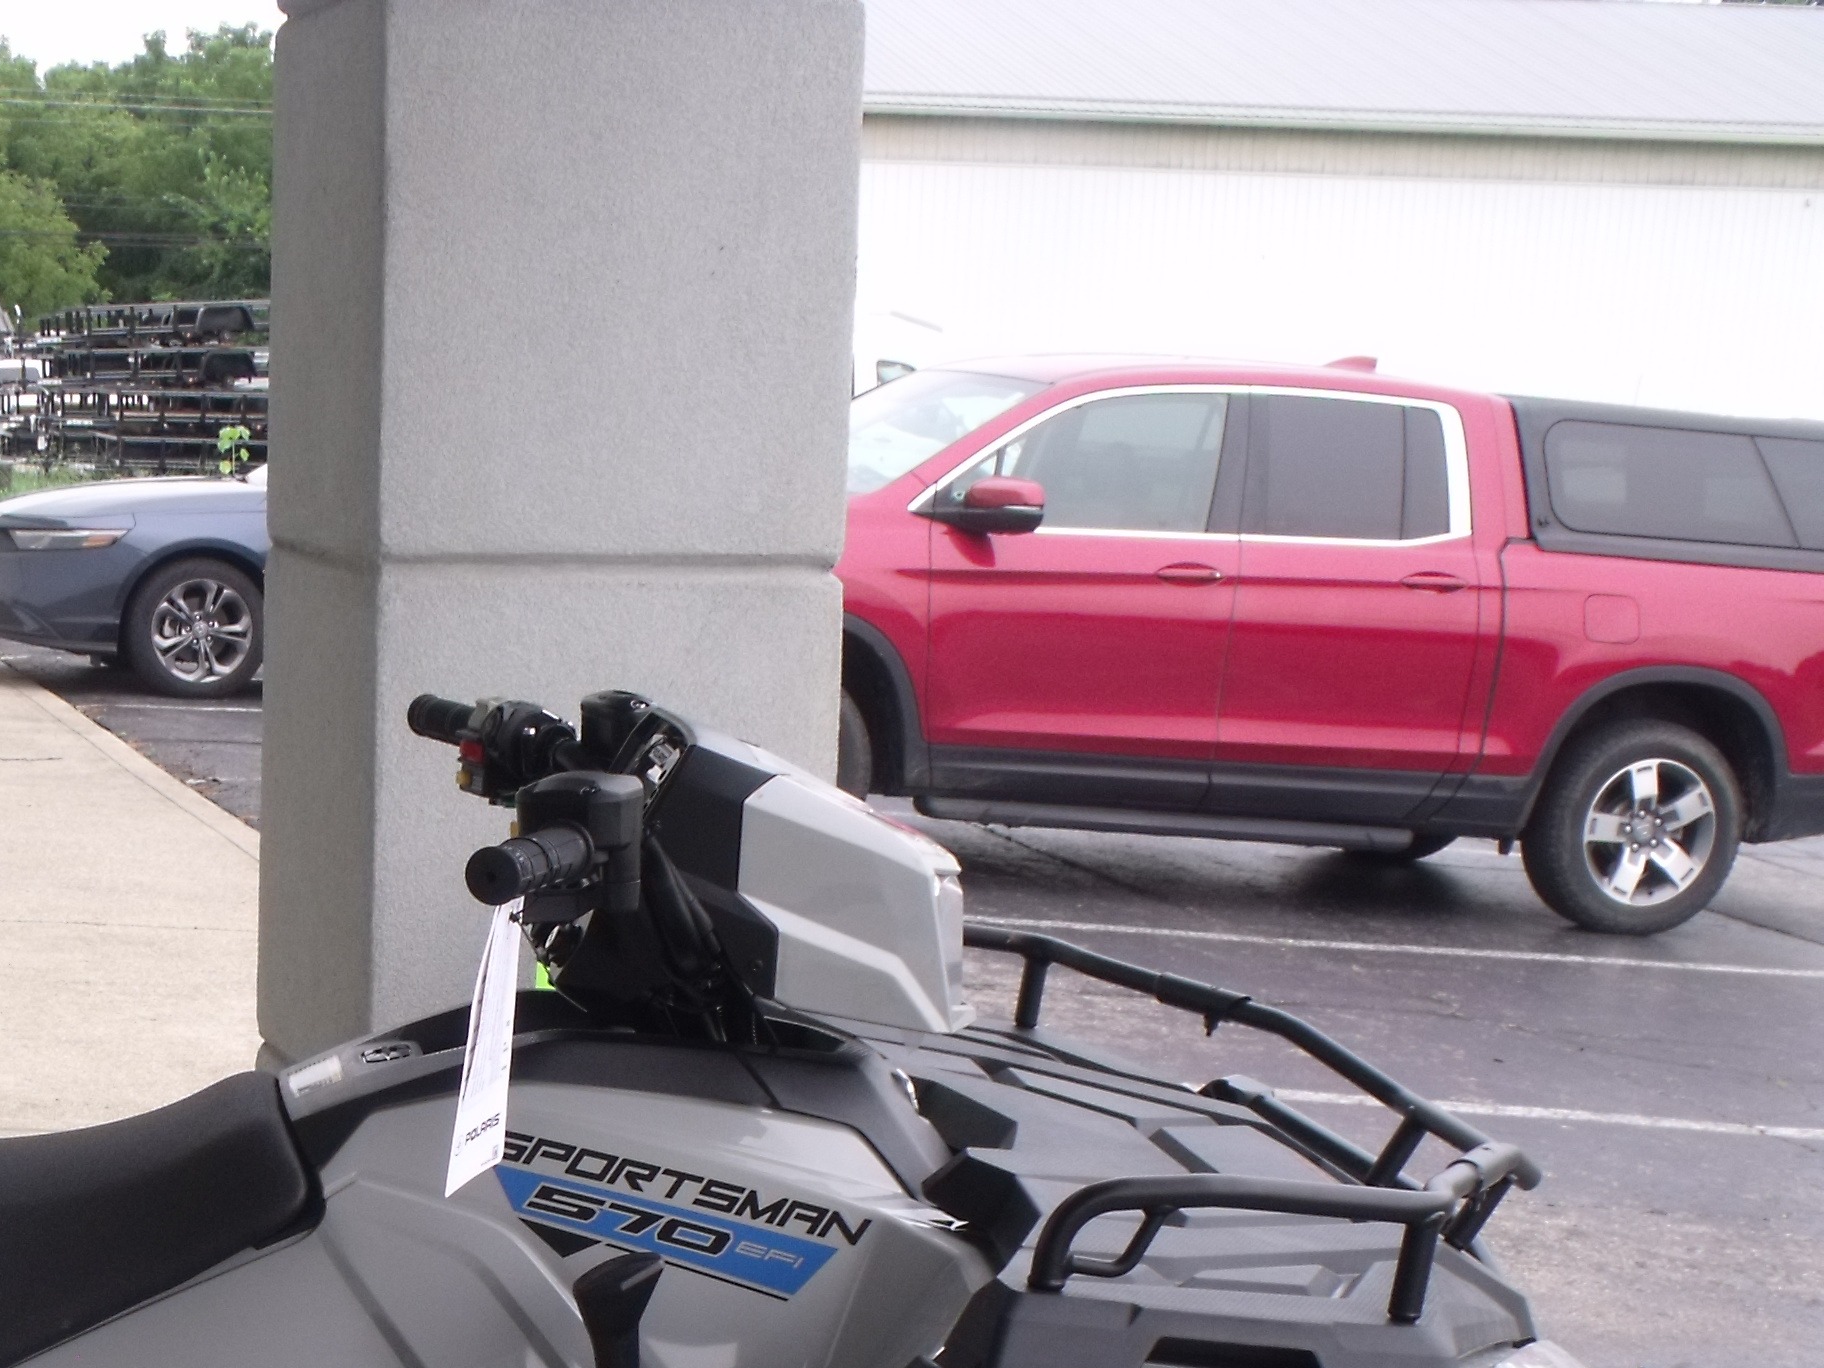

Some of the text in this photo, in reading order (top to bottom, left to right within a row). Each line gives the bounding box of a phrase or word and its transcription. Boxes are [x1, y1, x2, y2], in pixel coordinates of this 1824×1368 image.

[464, 1112, 500, 1145] POLARIS
[503, 1130, 873, 1246] SPORTSMAN
[523, 1183, 805, 1269] 570 EFI
